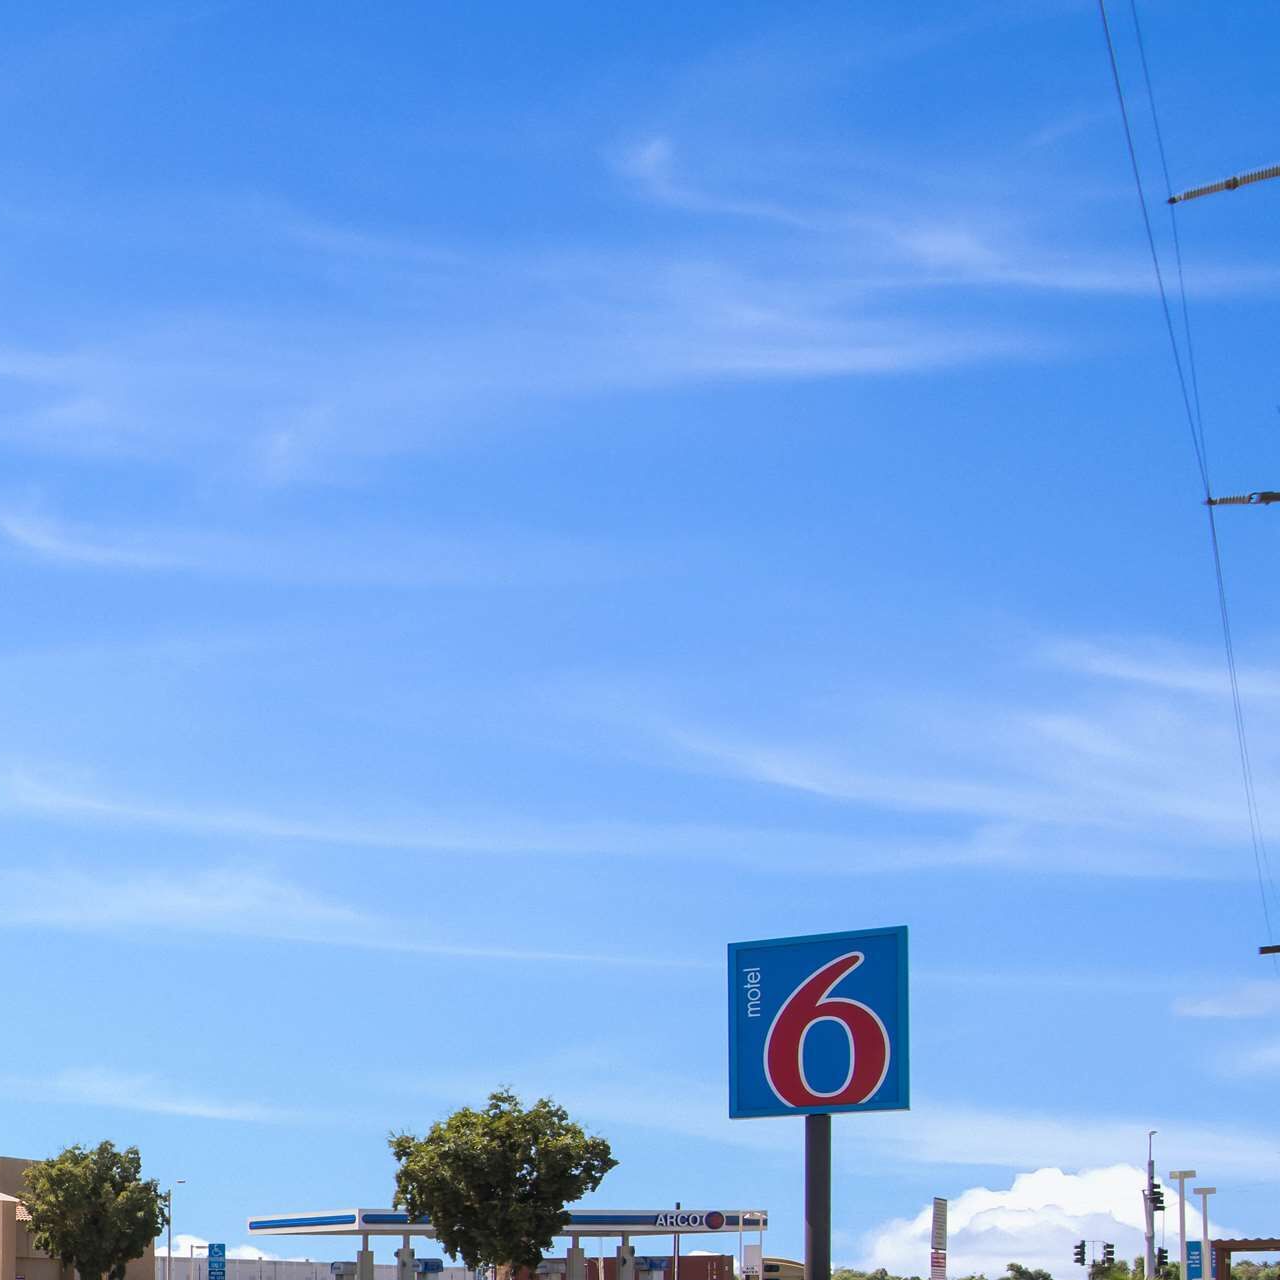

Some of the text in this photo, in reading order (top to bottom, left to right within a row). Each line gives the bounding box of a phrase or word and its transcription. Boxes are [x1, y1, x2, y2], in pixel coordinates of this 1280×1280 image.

[743, 967, 761, 1017] motel
[763, 951, 890, 1108] 6
[655, 1213, 701, 1227] ARCO
